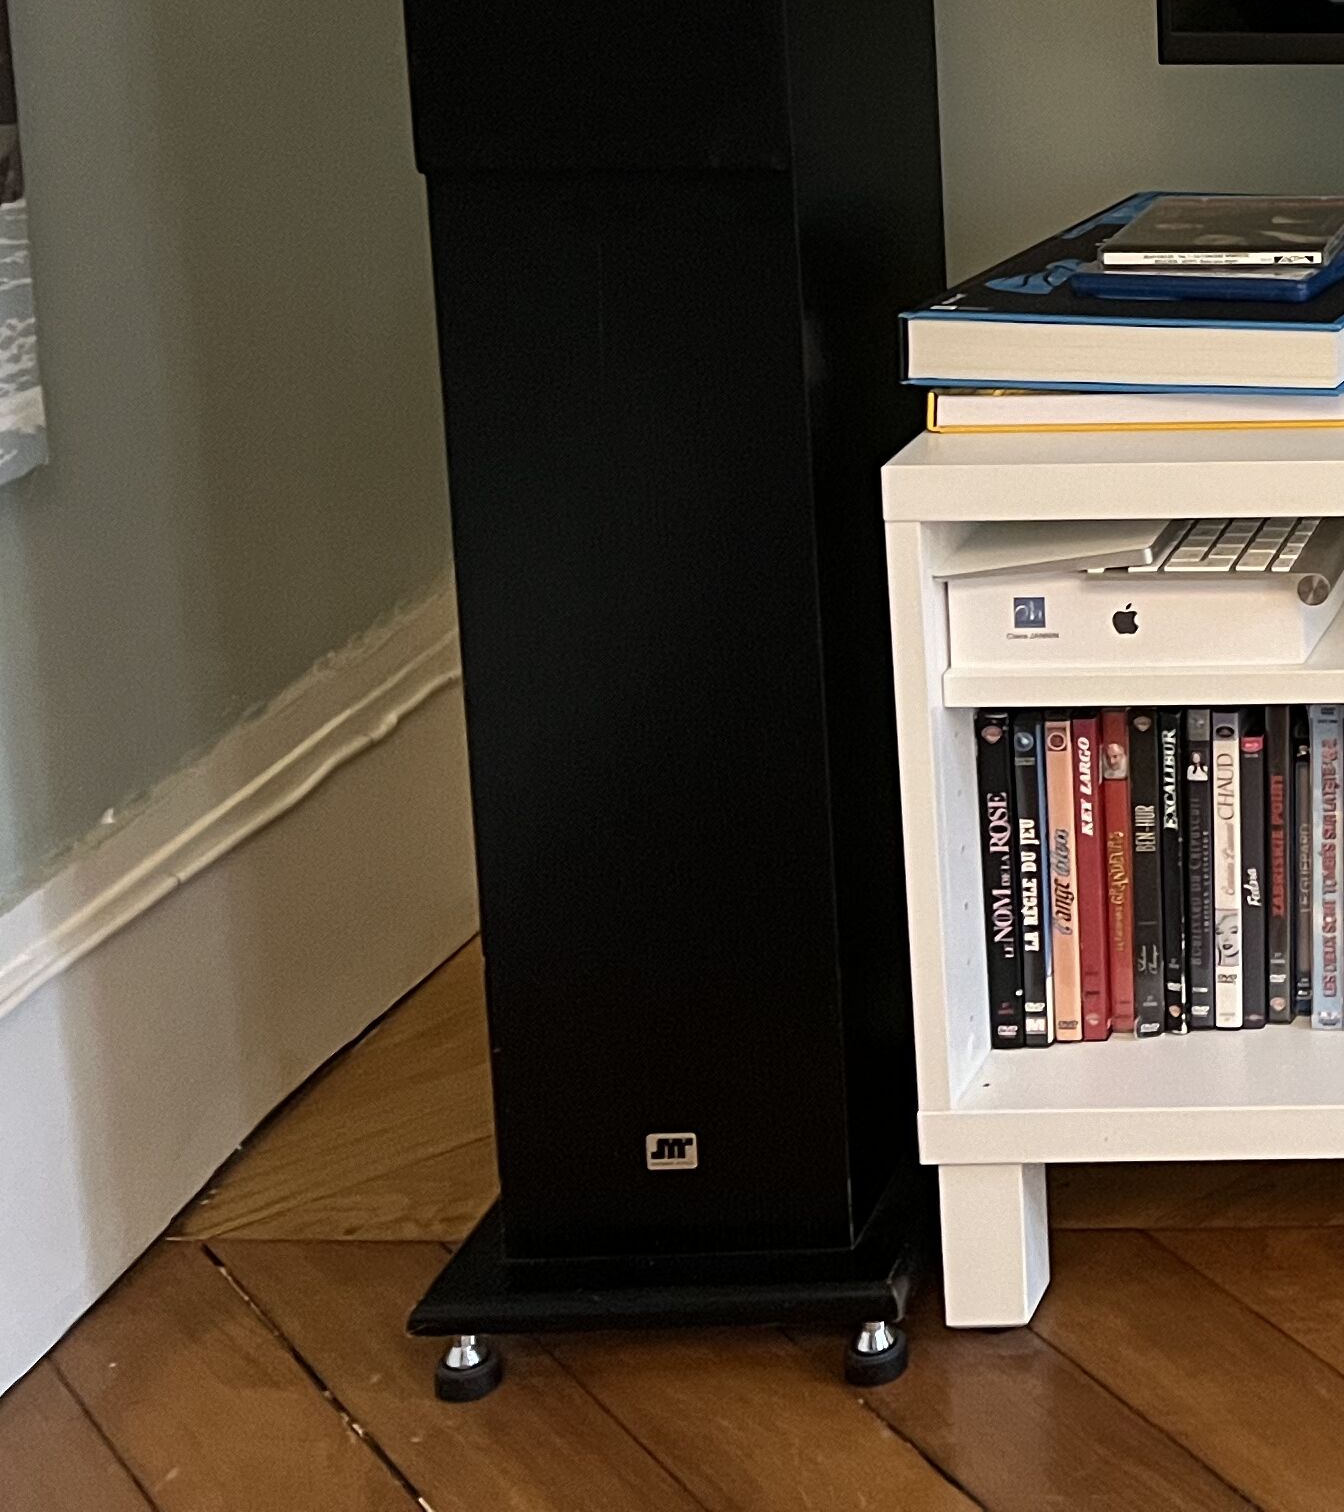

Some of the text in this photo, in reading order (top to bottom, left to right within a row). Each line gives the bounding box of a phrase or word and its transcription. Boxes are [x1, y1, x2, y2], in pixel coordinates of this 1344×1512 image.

[1078, 737, 1094, 835] KEY LARGO
[1162, 729, 1178, 830] EXCALIBUR
[1216, 753, 1234, 820] CHAUD
[987, 792, 1010, 852] ROSE
[1135, 806, 1156, 852] BEN-HUR
[1322, 814, 1336, 840] SUR
[1019, 819, 1039, 950] LA RÈGLE DU JEU
[992, 889, 1014, 941] NOM
[1322, 901, 1336, 933] SONT
